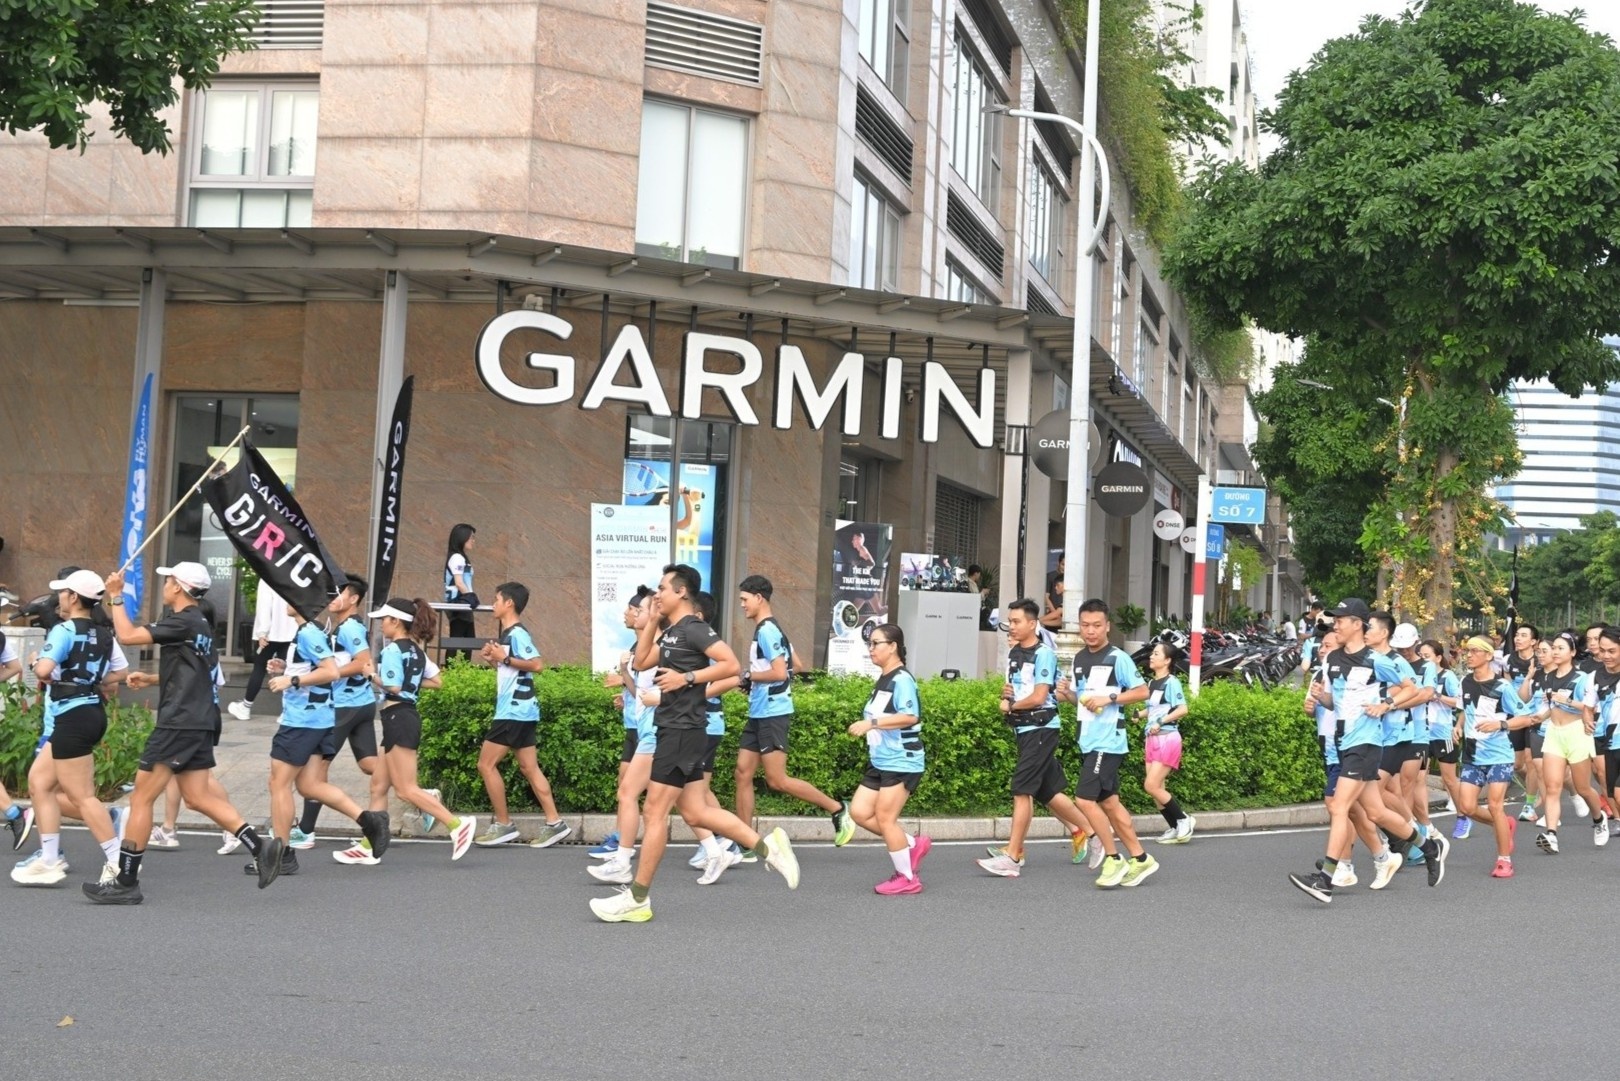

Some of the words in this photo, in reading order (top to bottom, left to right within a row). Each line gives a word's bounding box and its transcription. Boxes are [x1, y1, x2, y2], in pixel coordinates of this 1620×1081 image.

[475, 308, 995, 449] GARMIN
[1039, 439, 1091, 450] GAR
[382, 421, 403, 562] GARMIN
[1101, 485, 1144, 493] GARMIN
[249, 473, 316, 539] GARMIN
[1218, 503, 1243, 517] SỐ
[1246, 507, 1256, 517] 7
[596, 534, 614, 542] ASIA
[616, 534, 649, 543] VIRTUAL
[650, 535, 667, 543] RUN
